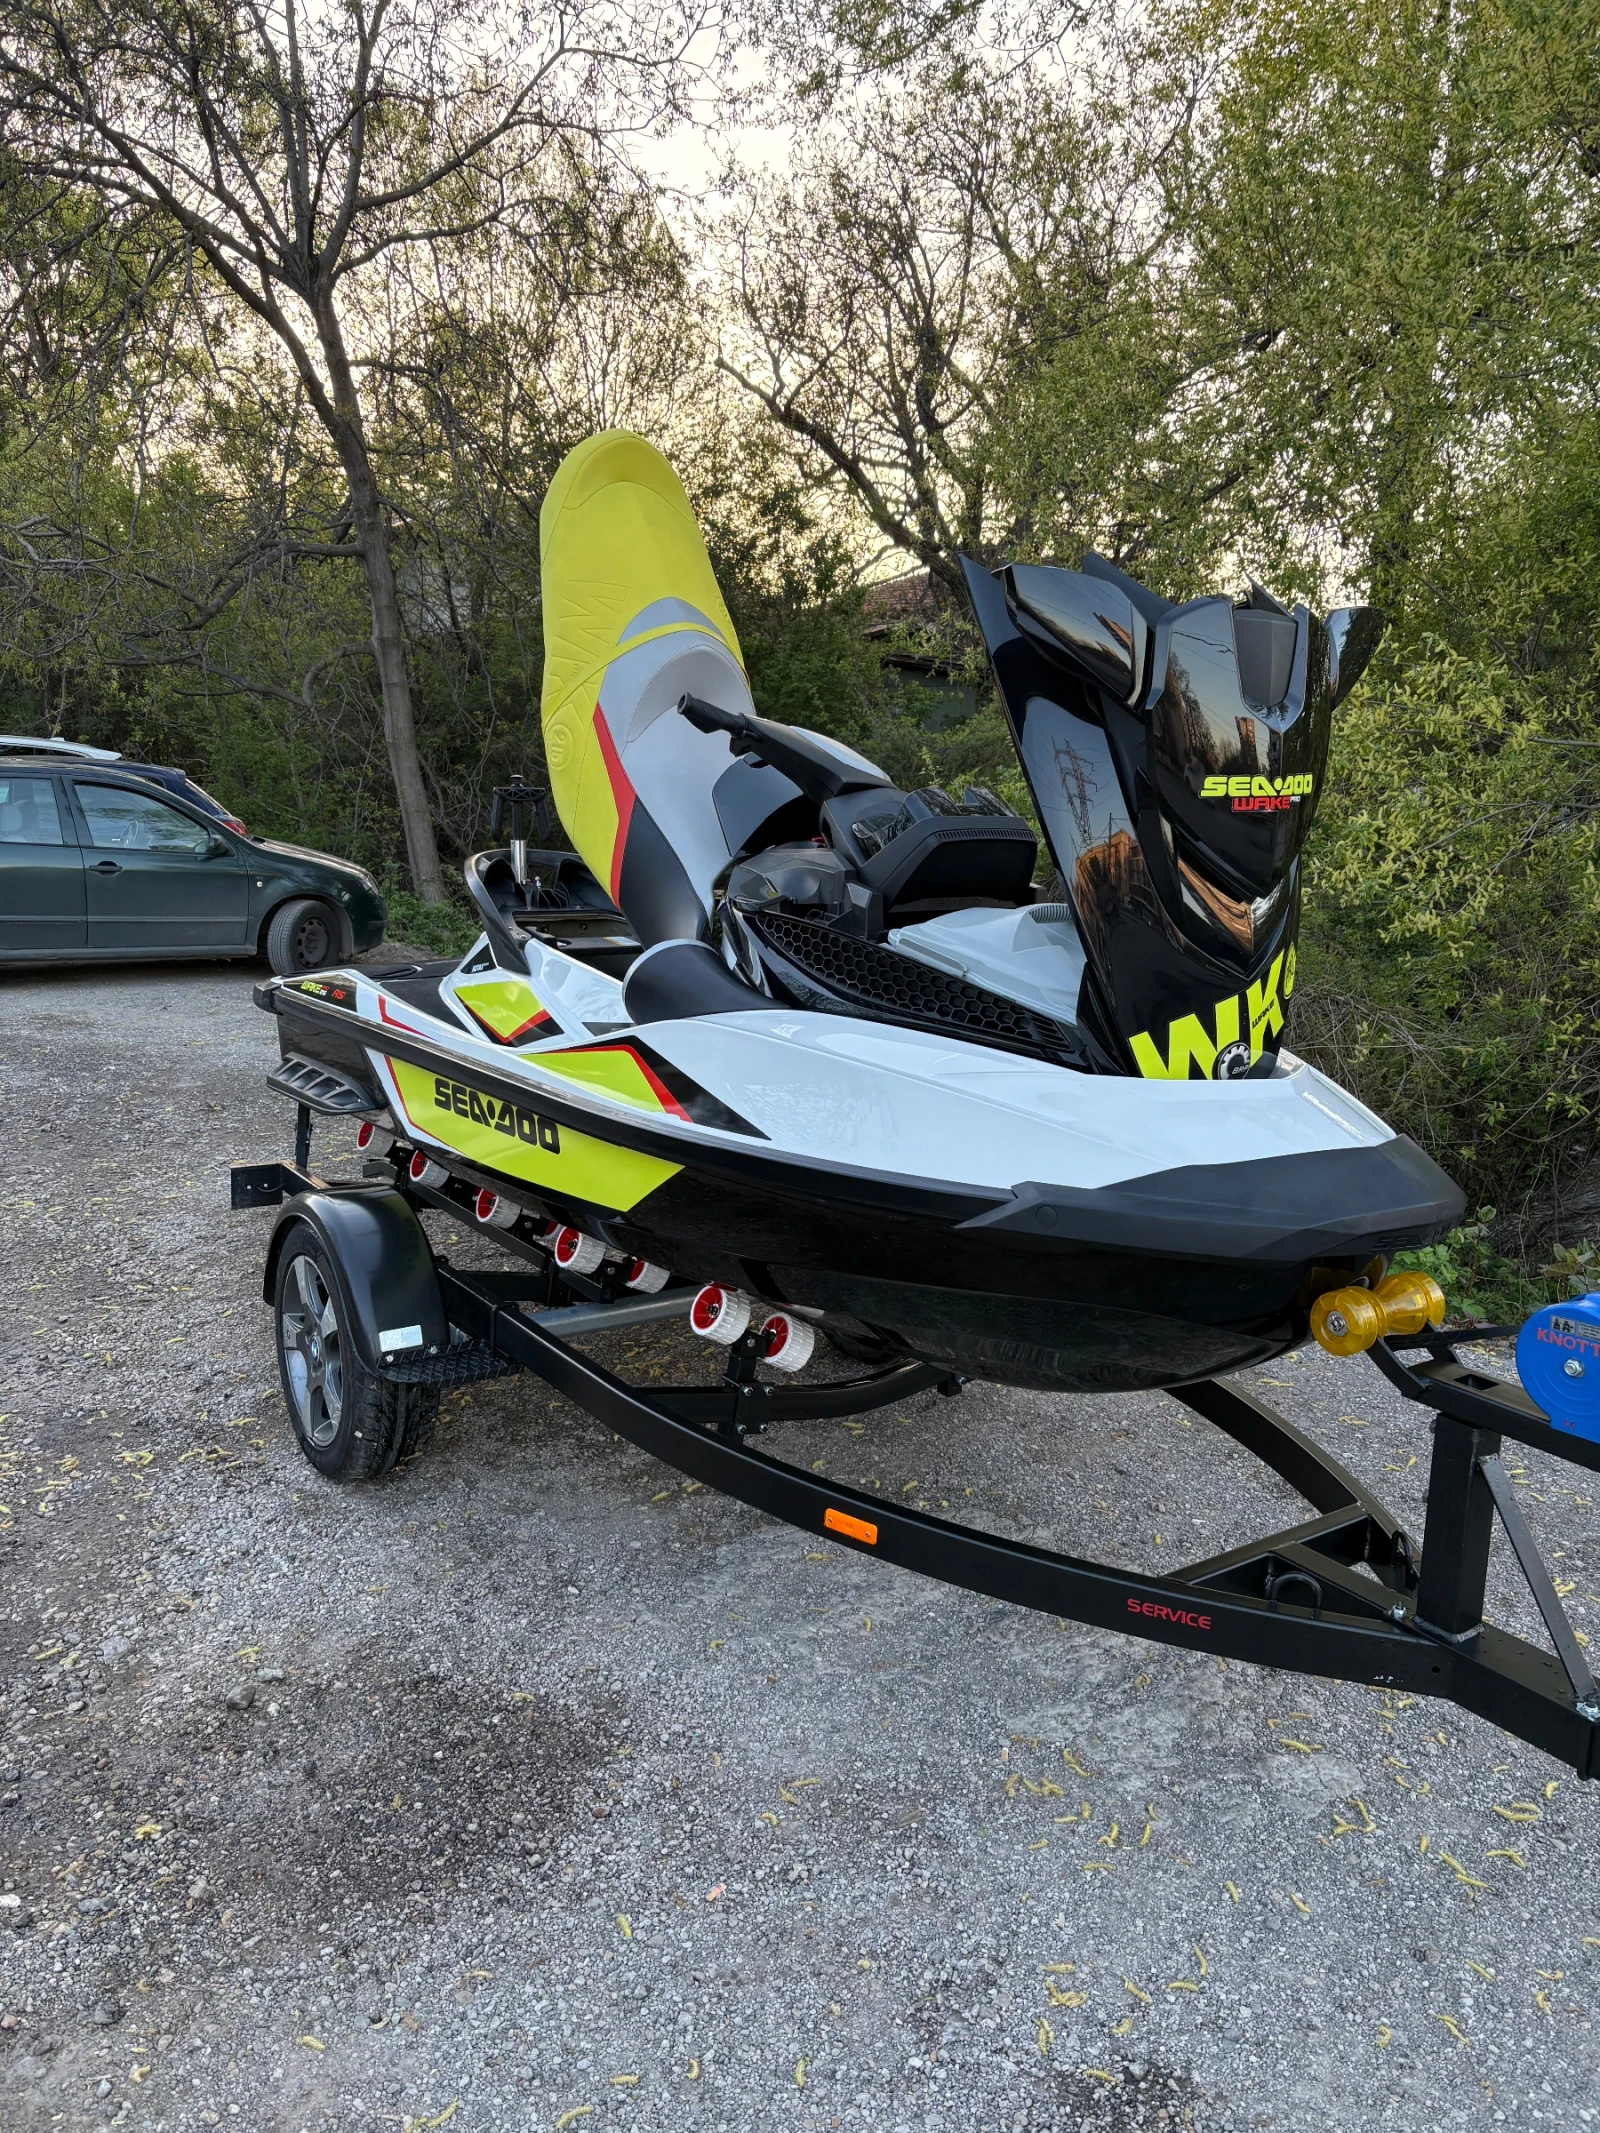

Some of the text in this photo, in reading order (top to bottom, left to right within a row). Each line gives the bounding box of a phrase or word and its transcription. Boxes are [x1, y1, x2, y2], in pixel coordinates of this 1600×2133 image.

[1232, 796, 1291, 811] WAKE
[1231, 1064, 1250, 1076] BRP
[1537, 1327, 1600, 1358] KNOTT
[1127, 1598, 1212, 1630] SERVICE
